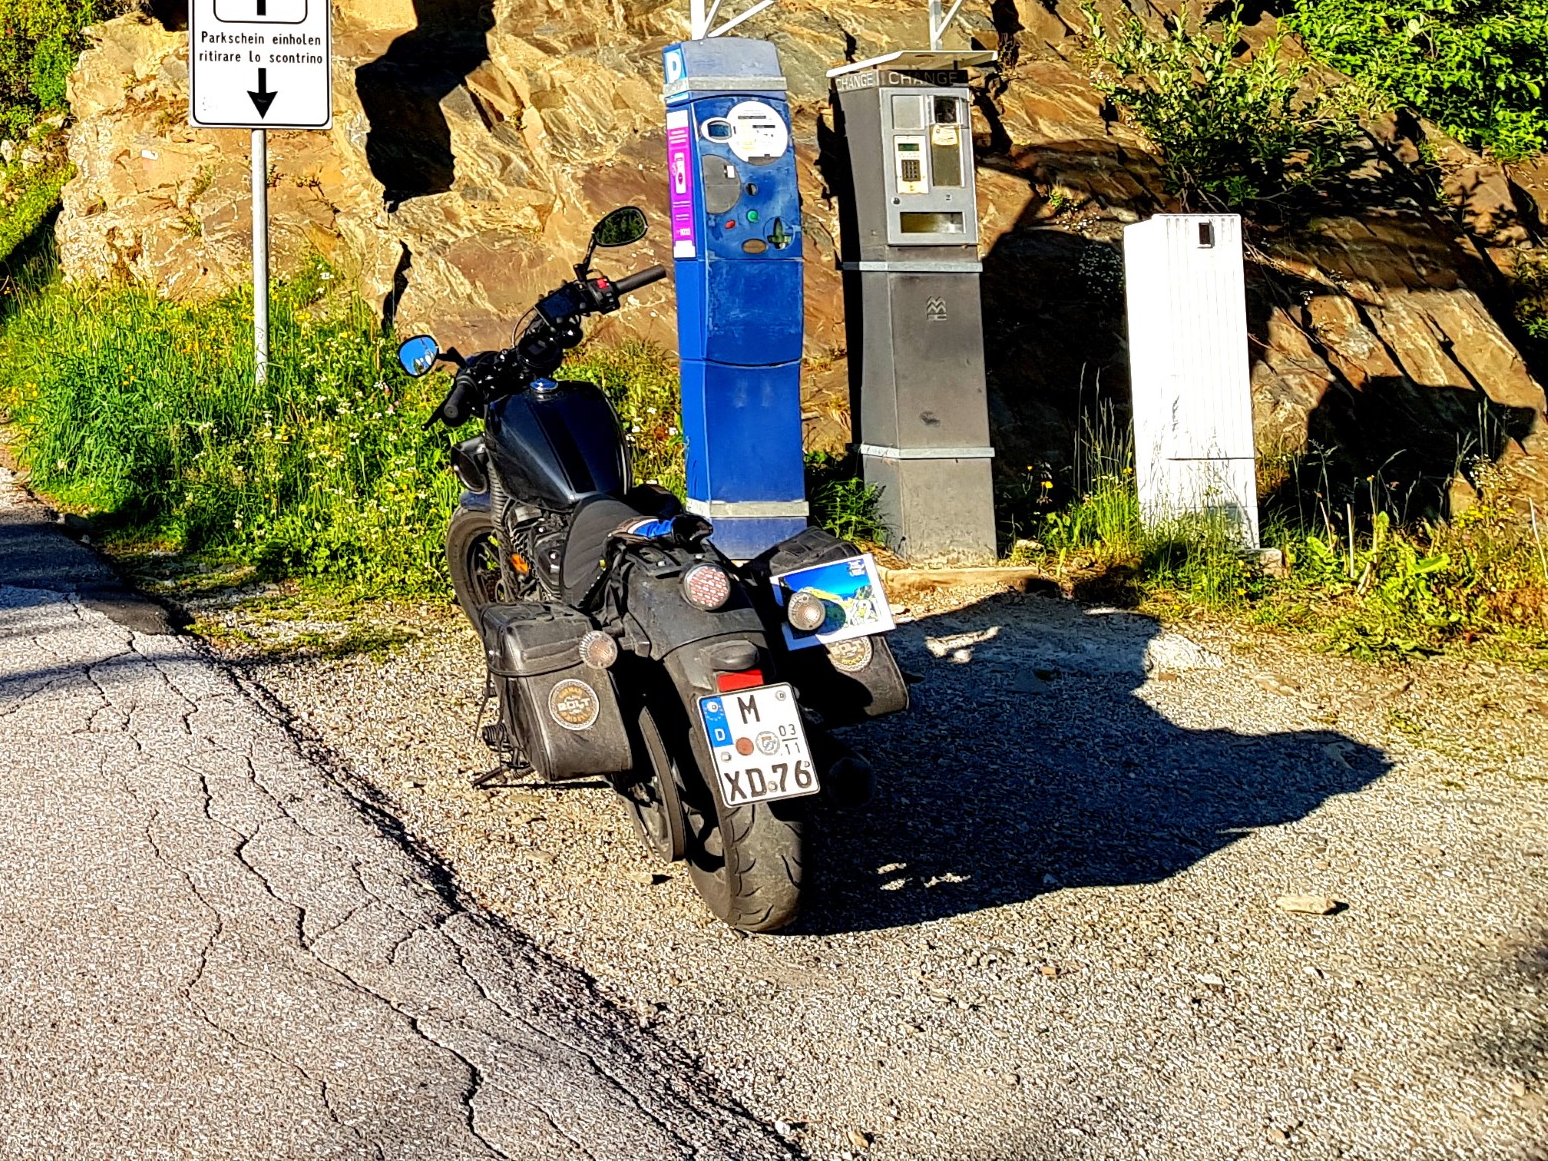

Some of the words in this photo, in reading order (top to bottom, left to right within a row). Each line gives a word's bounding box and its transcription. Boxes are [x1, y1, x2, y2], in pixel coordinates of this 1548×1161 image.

[201, 31, 265, 45] Parkschein
[272, 33, 321, 45] einholen
[199, 50, 241, 63] ritirare
[249, 51, 261, 63] lo
[269, 52, 323, 64] scontrino
[835, 72, 873, 91] CHANGE
[888, 71, 958, 86] CHANGE
[737, 694, 761, 725] M
[714, 728, 726, 741] D
[778, 723, 797, 738] 03
[784, 742, 801, 756] 11
